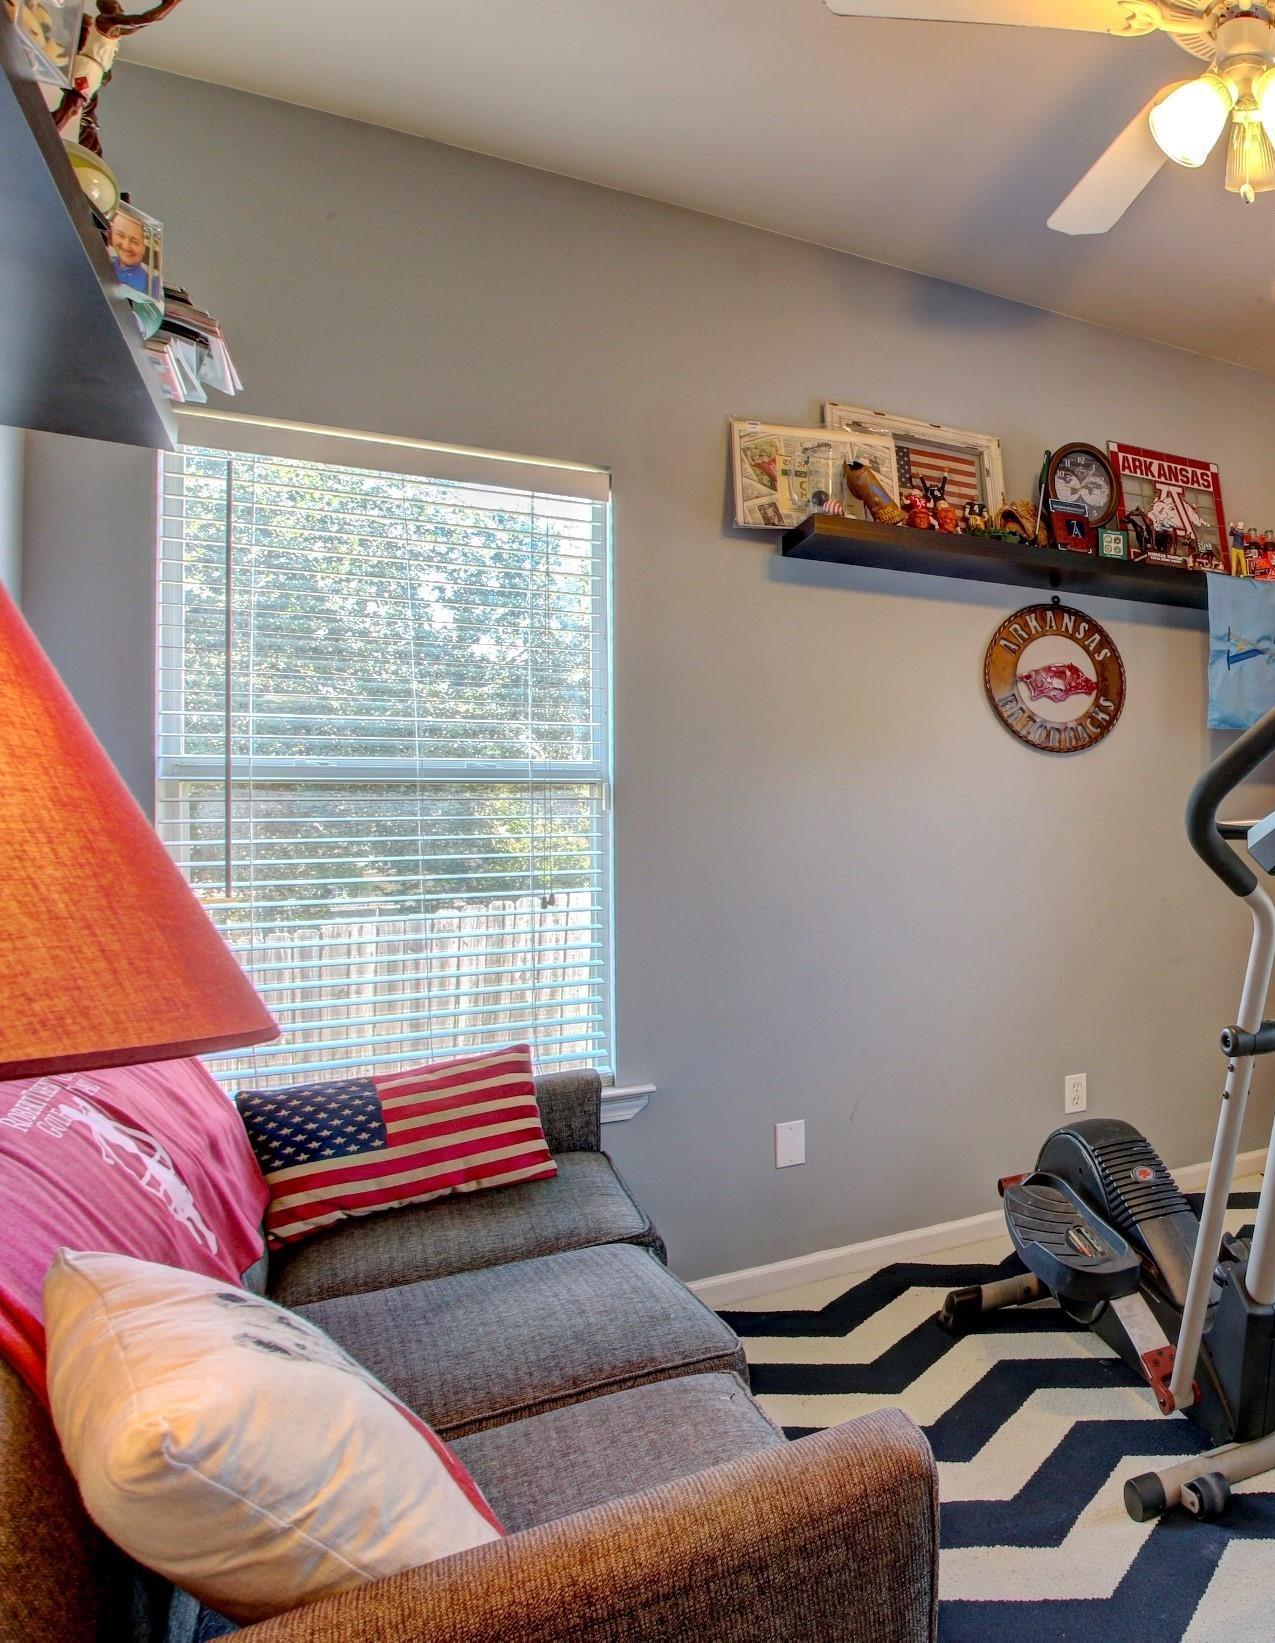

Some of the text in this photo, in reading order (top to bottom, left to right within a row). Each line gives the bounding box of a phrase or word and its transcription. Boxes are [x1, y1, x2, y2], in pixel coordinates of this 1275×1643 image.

[1121, 455, 1212, 489] ARKANSAS
[999, 610, 1112, 661] ARKANSAS
[998, 692, 1115, 748] RAZORBACKS
